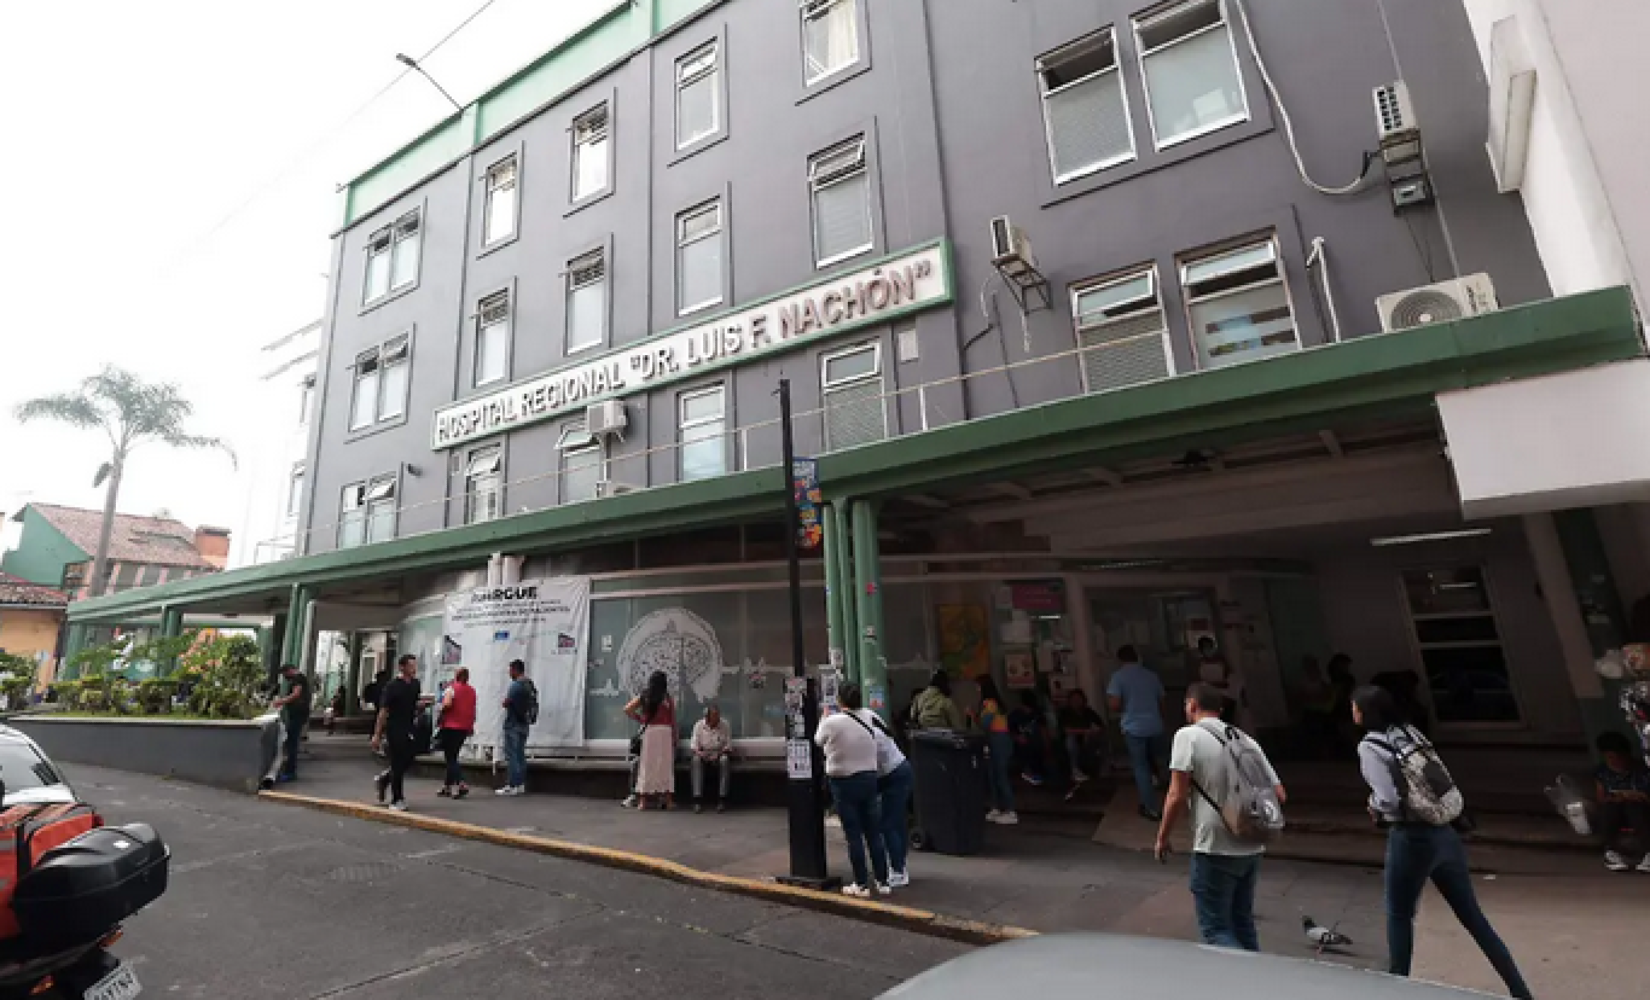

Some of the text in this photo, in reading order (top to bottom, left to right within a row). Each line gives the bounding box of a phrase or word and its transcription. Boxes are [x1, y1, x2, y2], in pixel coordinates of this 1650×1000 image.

[438, 395, 518, 443] HOSPITAL
[521, 363, 626, 416] REGIONAL
[688, 323, 743, 366] LUIS
[749, 313, 772, 349] F.
